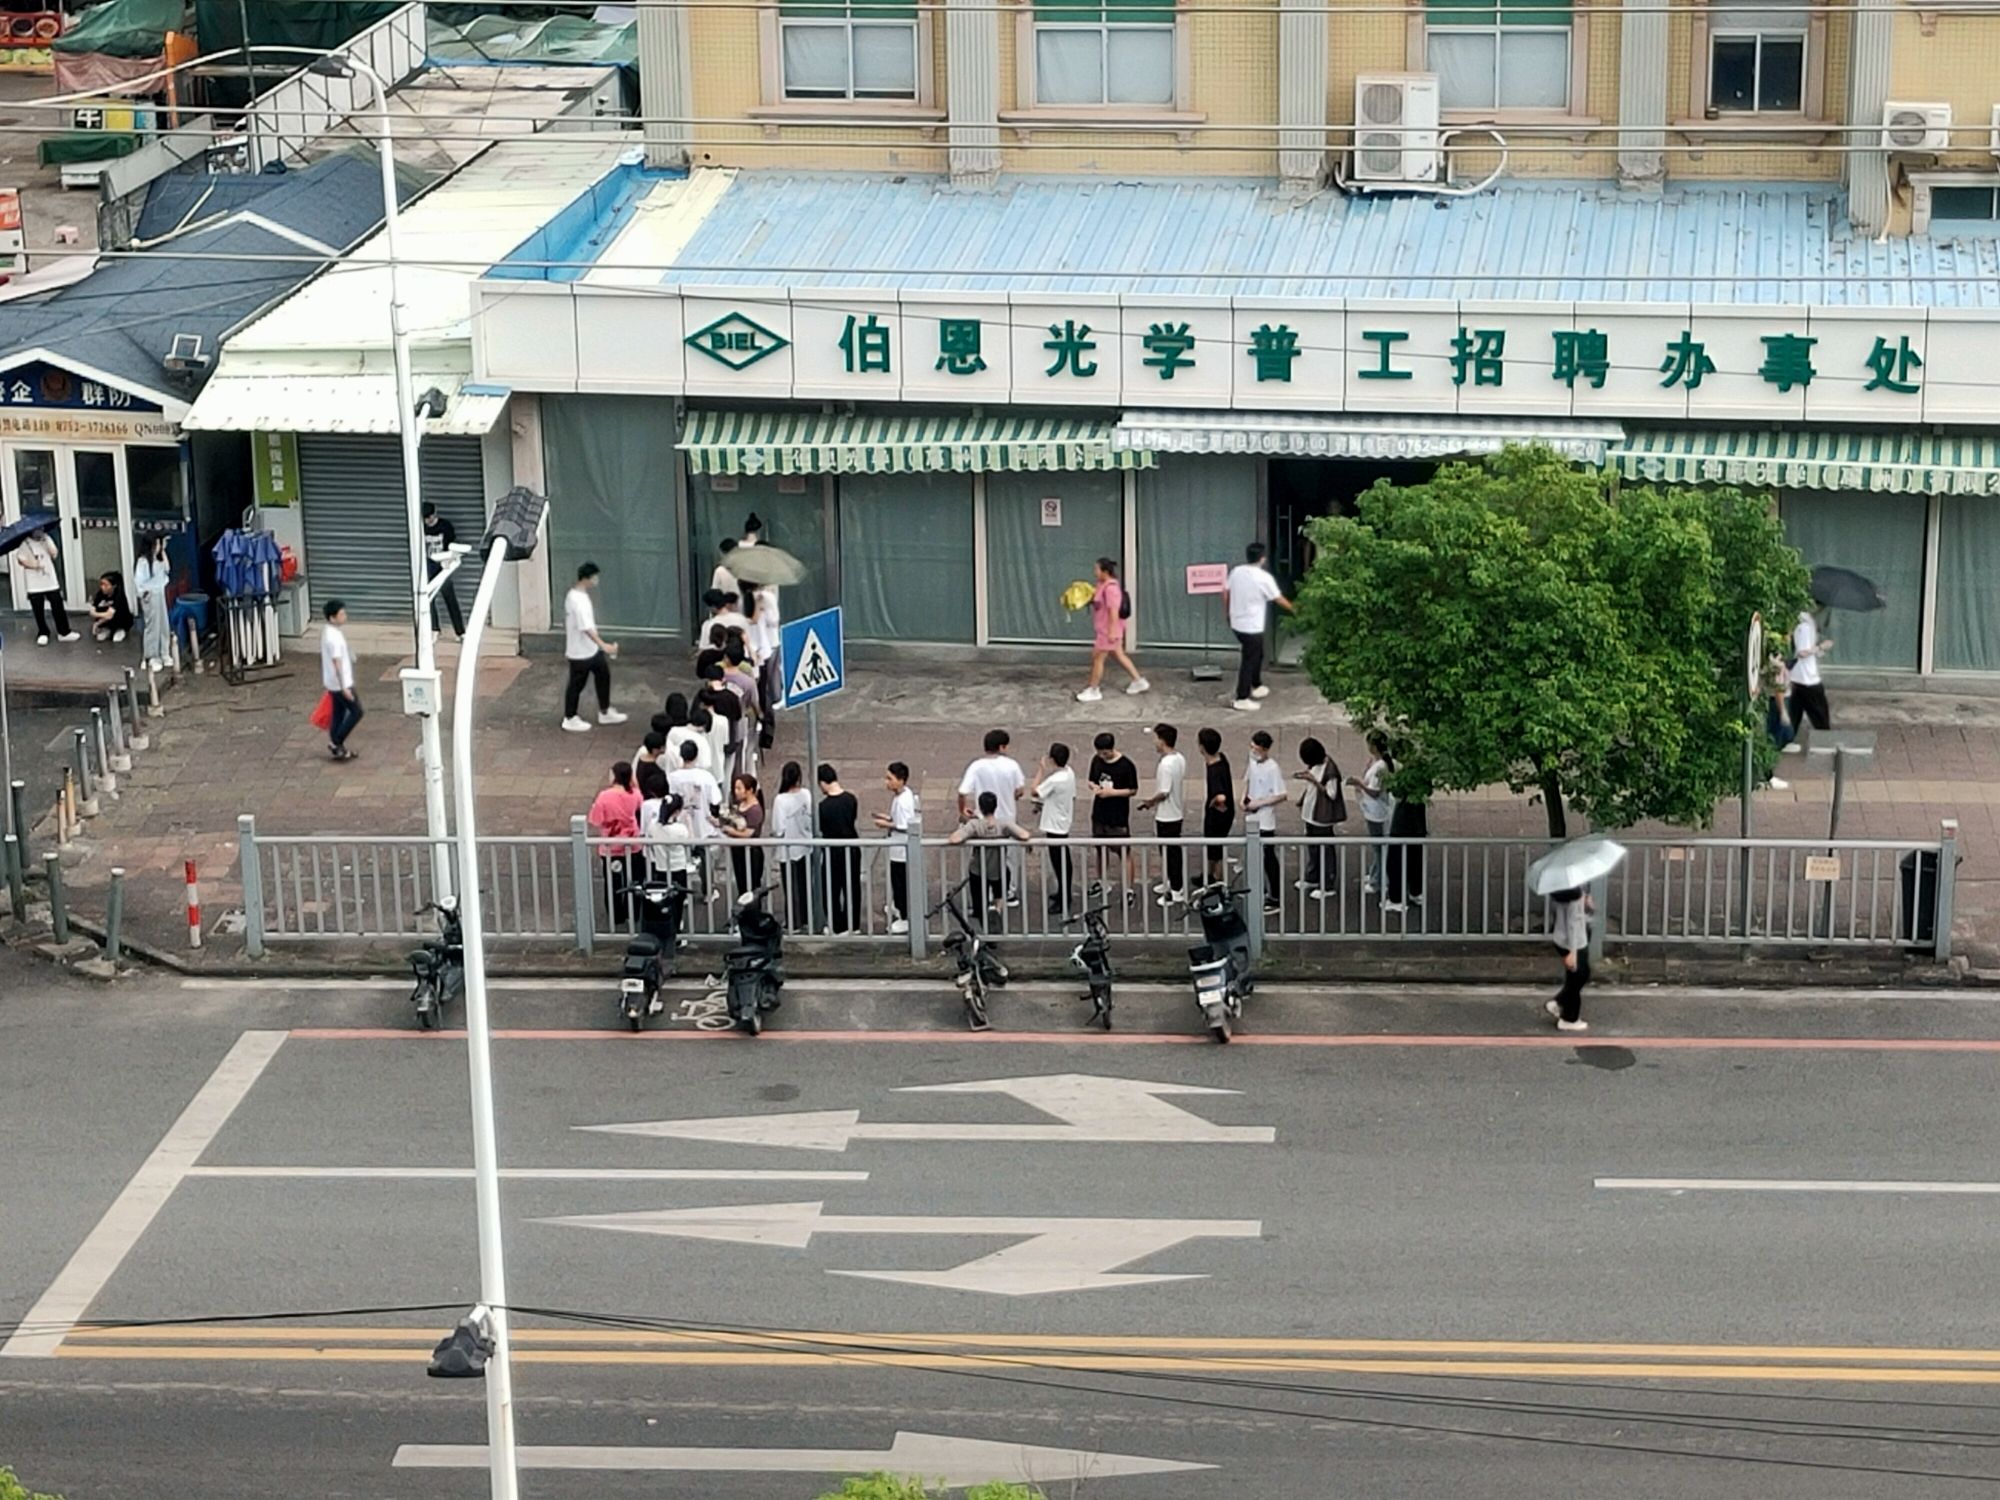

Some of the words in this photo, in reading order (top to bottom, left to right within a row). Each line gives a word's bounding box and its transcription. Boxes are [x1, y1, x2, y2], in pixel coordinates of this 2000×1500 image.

[710, 332, 763, 350] BIEL
[838, 313, 1923, 394] 伯恩光学普工招聘办事处
[0, 417, 51, 432] 警电话110
